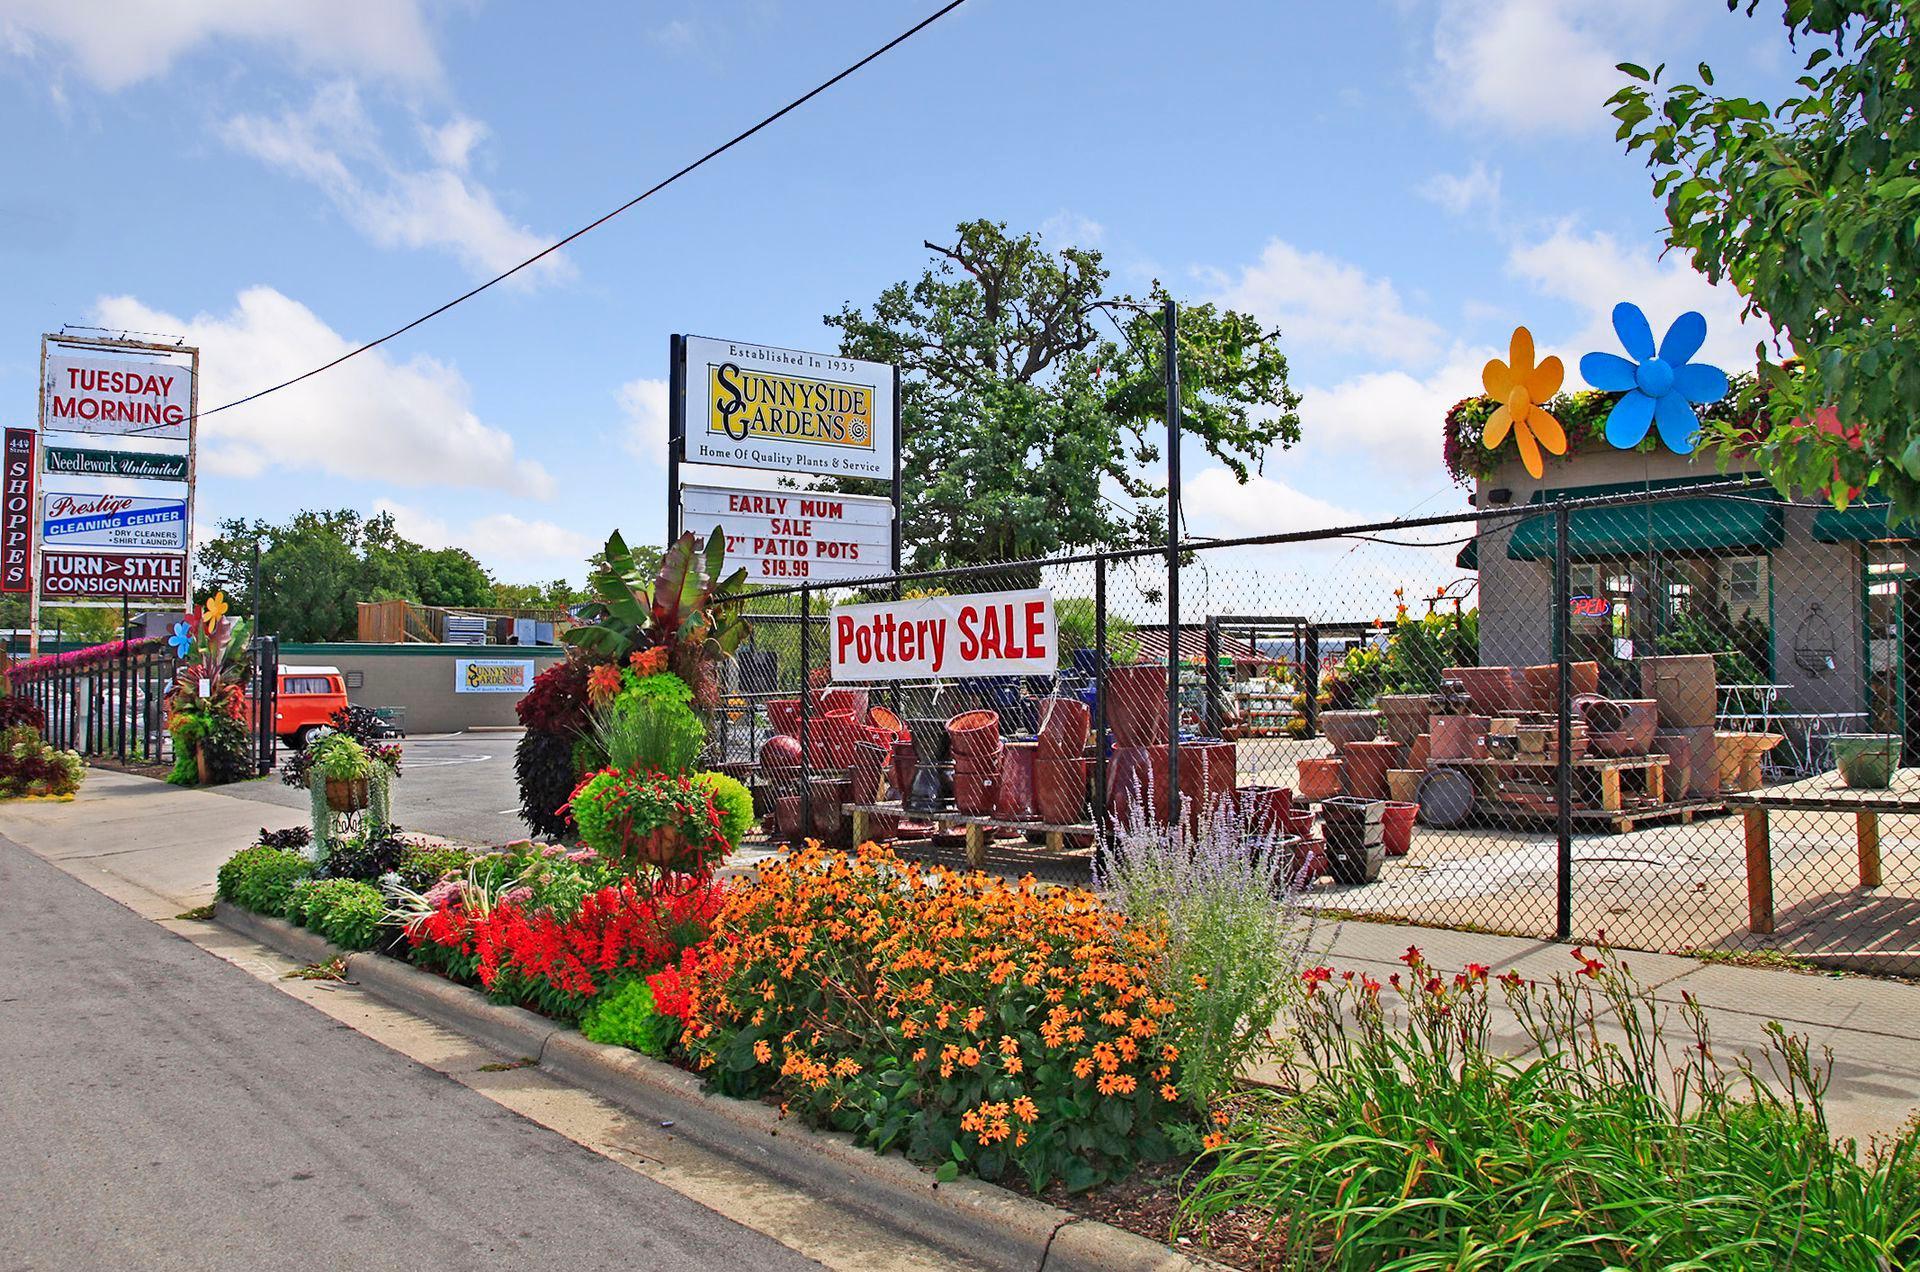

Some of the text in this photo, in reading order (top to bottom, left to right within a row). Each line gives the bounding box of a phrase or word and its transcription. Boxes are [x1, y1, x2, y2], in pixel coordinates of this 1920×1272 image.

[730, 345, 855, 373] Established In 1935
[67, 368, 174, 397] TUESDAY
[717, 363, 867, 416] SUNNYSIDE
[53, 395, 184, 425] MORNING
[717, 398, 845, 441] GARDENS
[51, 451, 184, 476] Needlework Unlimited
[700, 445, 880, 472] Home Of Quality Plants & Service
[49, 494, 133, 518] Prestige
[729, 494, 843, 519] EARLY MUM
[6, 462, 29, 582] SHOPPES
[49, 511, 179, 535] CLEANING CENTER
[115, 529, 177, 539] DRY CLEANERS
[771, 518, 812, 537] SALE
[141, 538, 178, 546] LAUNDRY
[754, 538, 812, 557] PATIO
[816, 541, 859, 560] POTS
[46, 556, 181, 577] TURN STYLE
[762, 559, 809, 577] $19.99
[46, 577, 181, 593] CONSIGNMENT
[836, 601, 1046, 673] Pottery SALE
